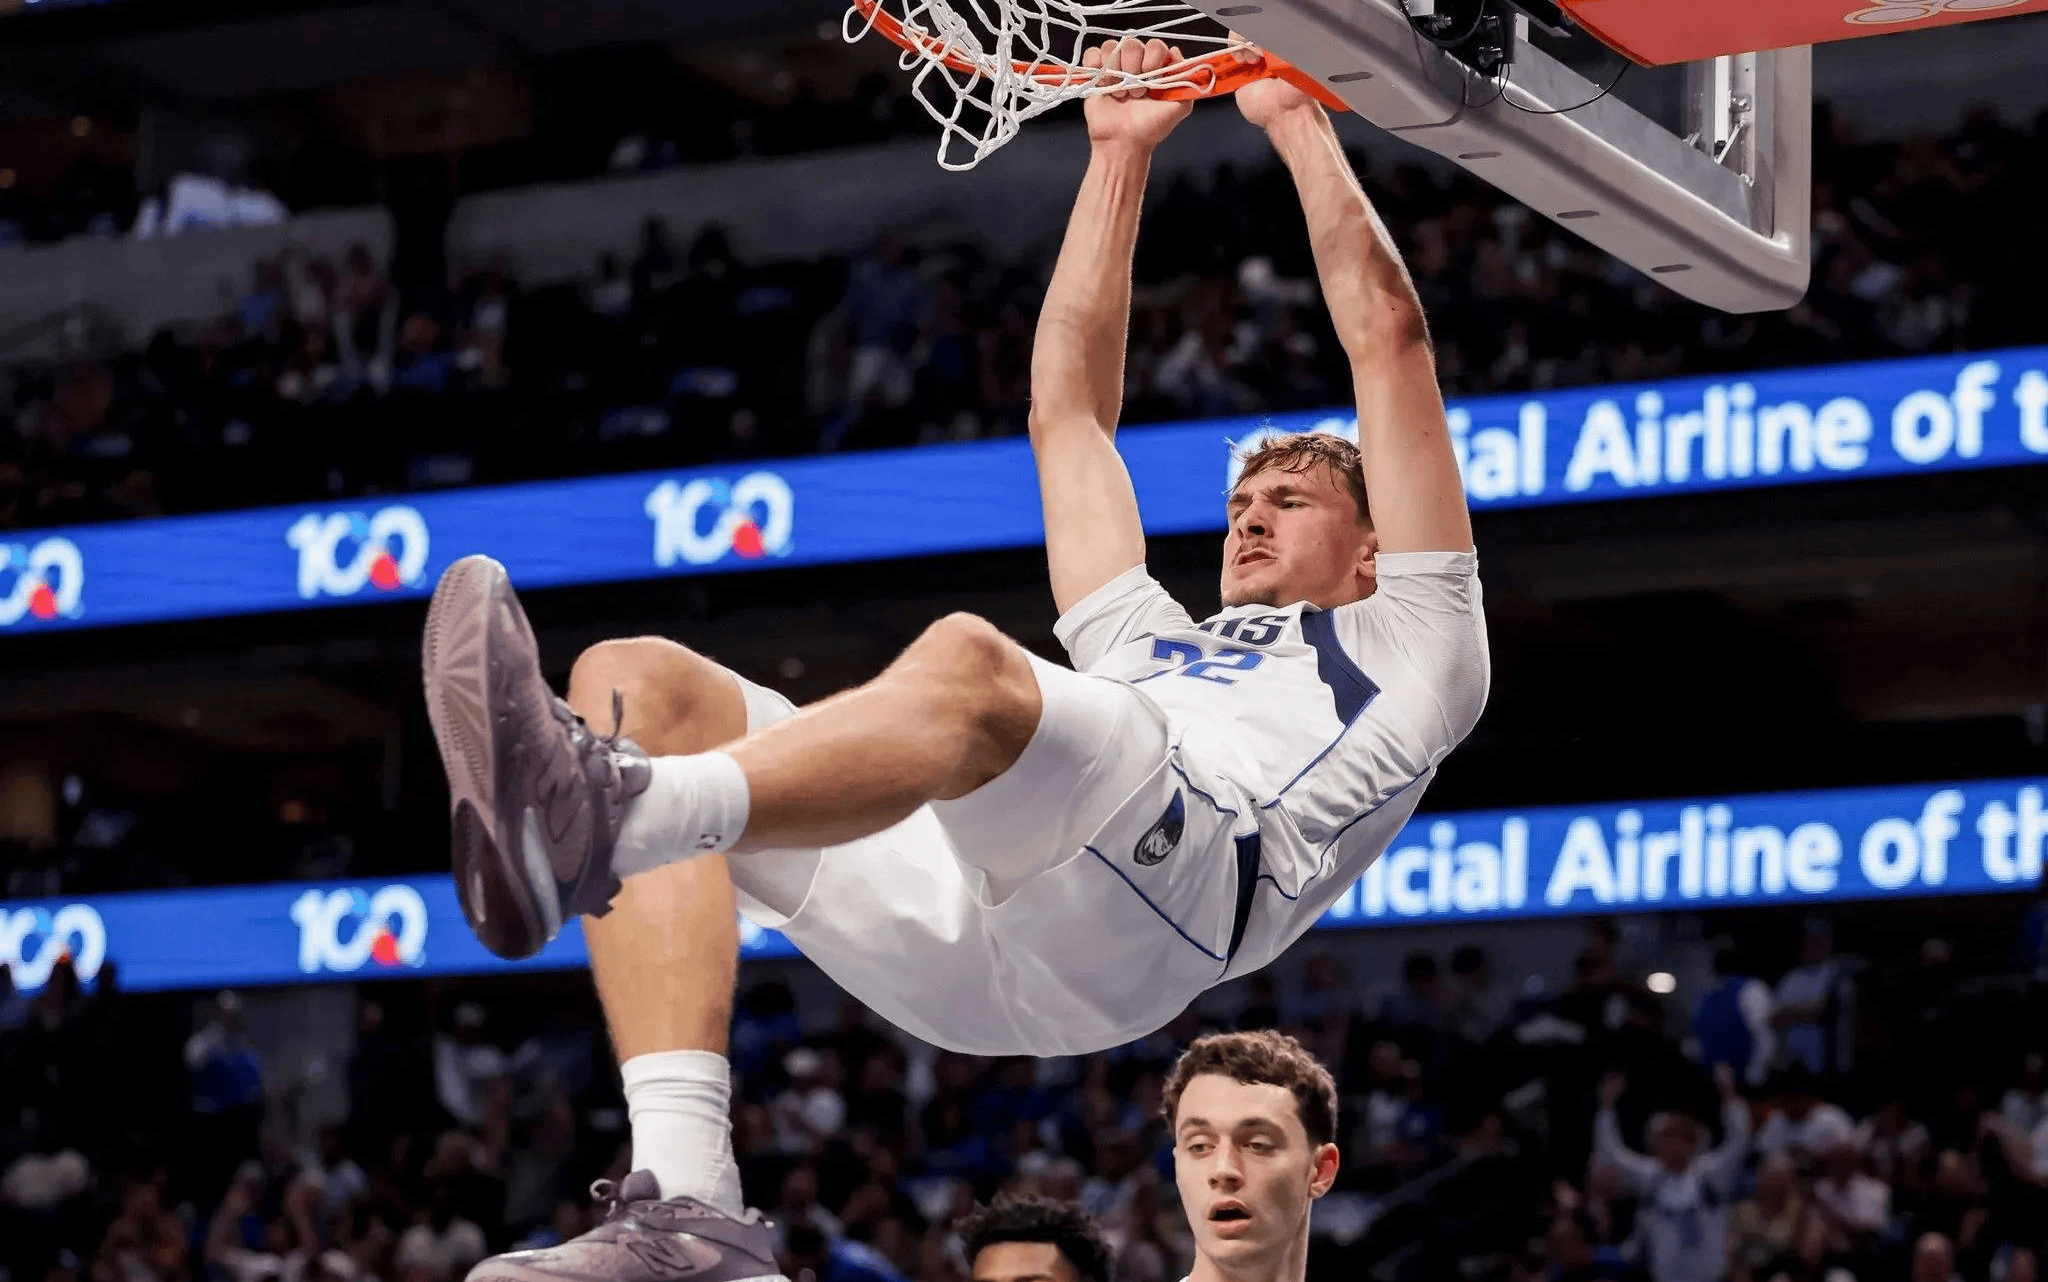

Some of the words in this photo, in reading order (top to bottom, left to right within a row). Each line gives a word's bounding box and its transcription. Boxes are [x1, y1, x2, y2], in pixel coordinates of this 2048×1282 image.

[1565, 383, 1872, 493] Airline
[1891, 359, 2001, 463] of
[286, 505, 430, 600] 100
[645, 471, 794, 567] 100
[1330, 817, 1530, 918] icial
[1545, 802, 1842, 907] Airline
[1860, 789, 1967, 890] of
[1977, 785, 2048, 883] th
[290, 884, 428, 973] 100
